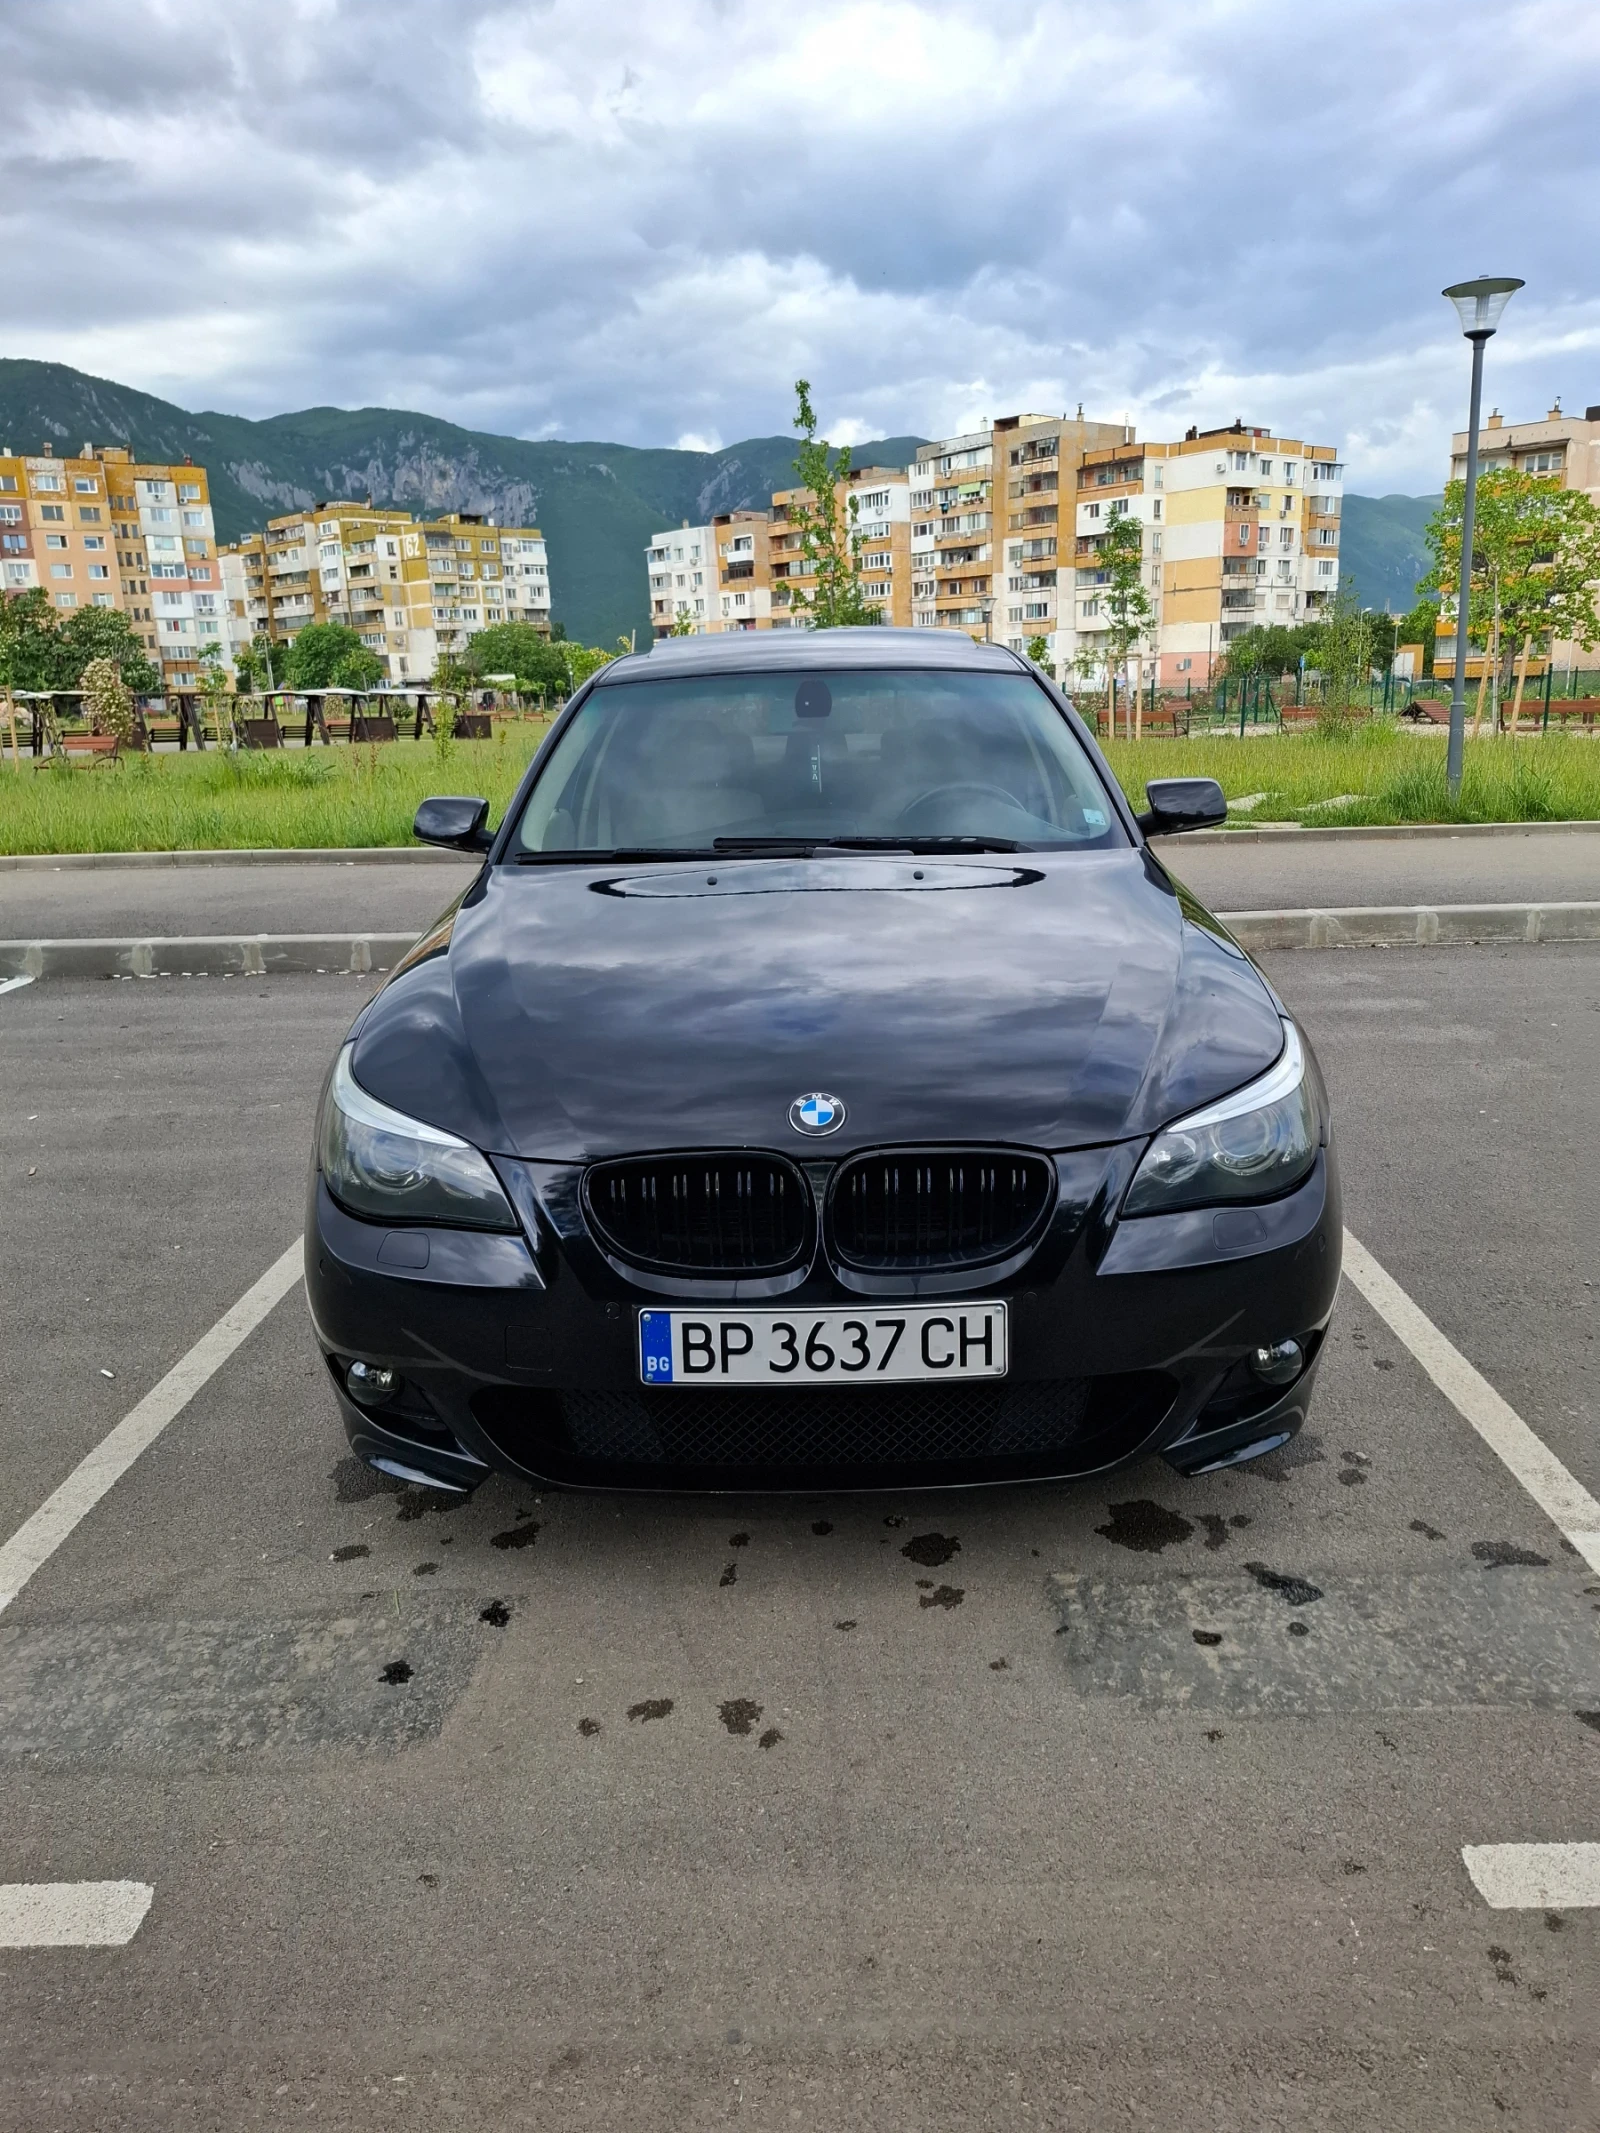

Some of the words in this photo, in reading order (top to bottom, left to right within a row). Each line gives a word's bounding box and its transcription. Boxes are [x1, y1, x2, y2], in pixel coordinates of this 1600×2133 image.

[406, 535, 420, 557] 62
[795, 1094, 840, 1107] BMW
[681, 1322, 753, 1373] BP
[769, 1319, 906, 1373] 3637
[921, 1315, 993, 1369] CH
[647, 1356, 669, 1371] BG
